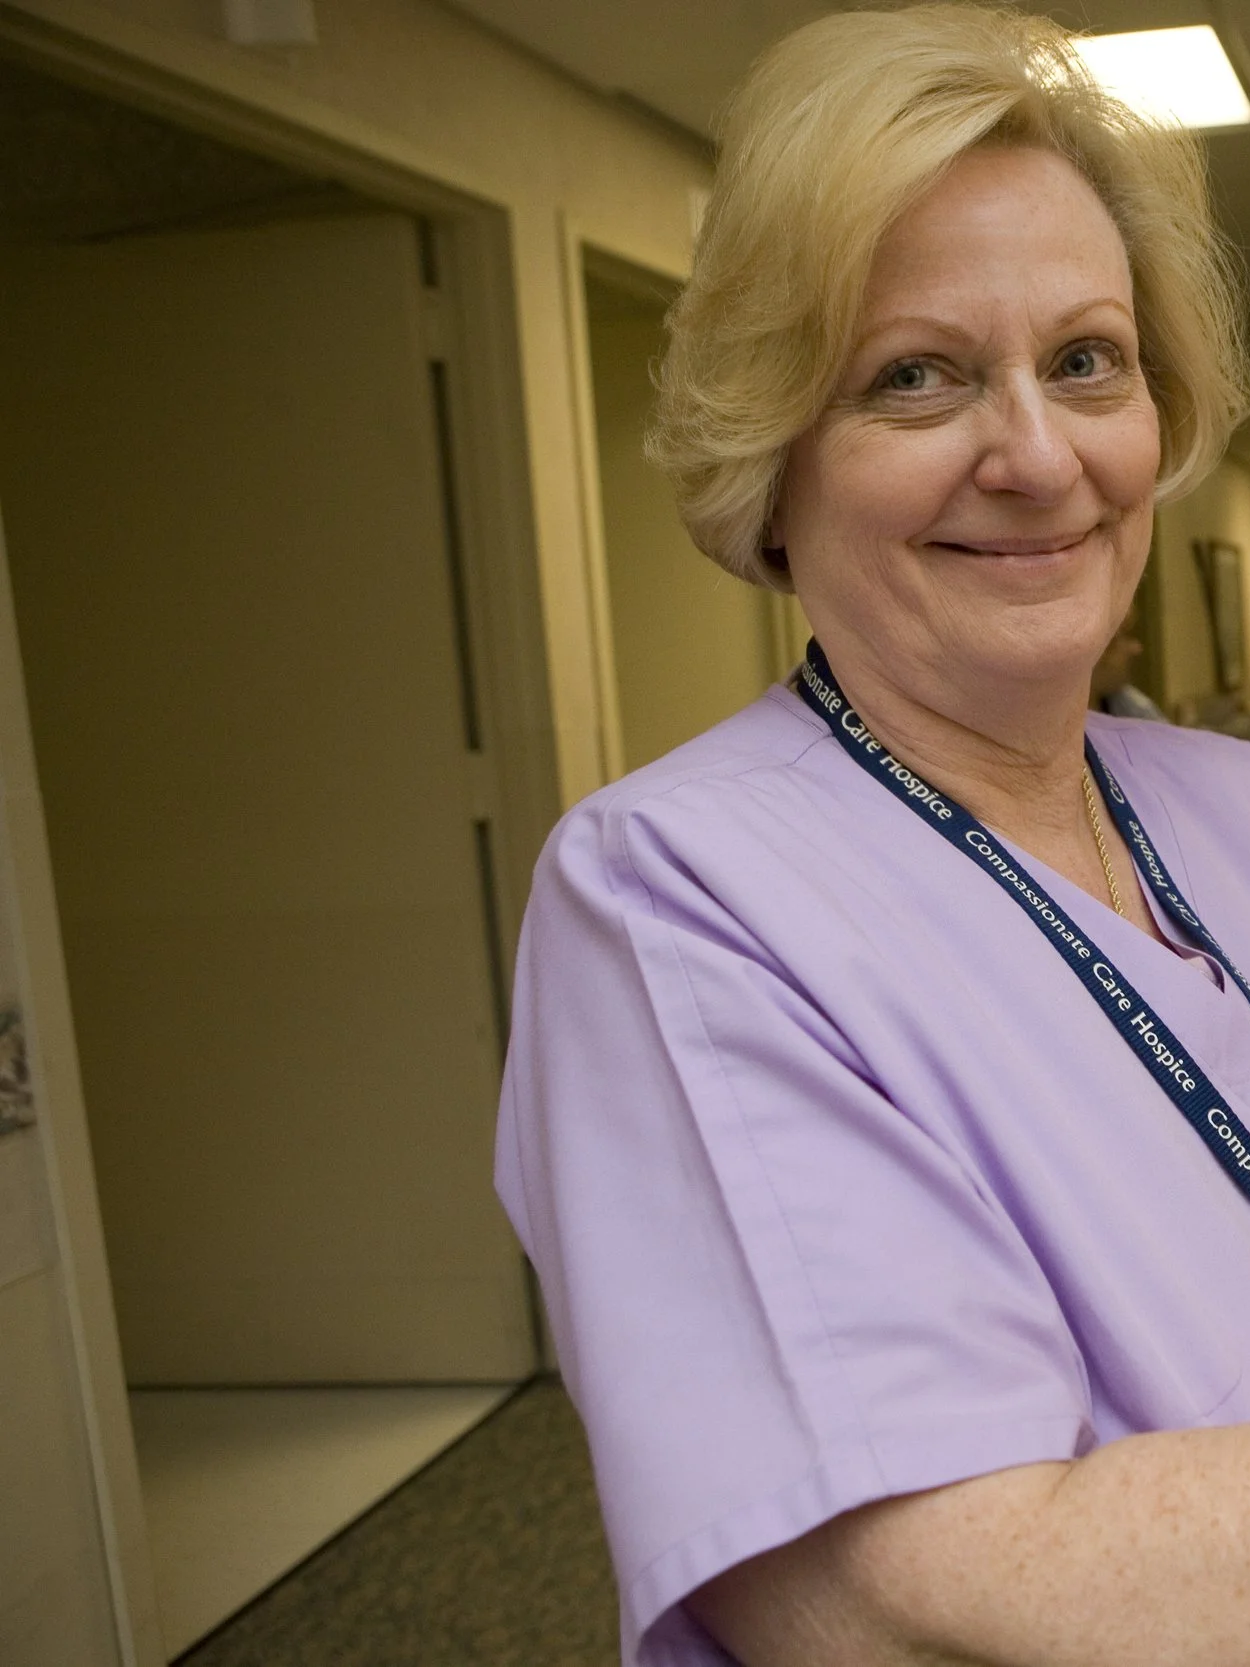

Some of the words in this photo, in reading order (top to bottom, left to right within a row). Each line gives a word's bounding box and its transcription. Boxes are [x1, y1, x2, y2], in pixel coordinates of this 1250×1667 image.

[1128, 820, 1169, 888] Hospice
[840, 708, 882, 754] Care
[965, 830, 1091, 959] Compassionate
[1092, 962, 1131, 1011] Care
[1131, 1011, 1196, 1092] Hospice
[1167, 891, 1199, 927] Care
